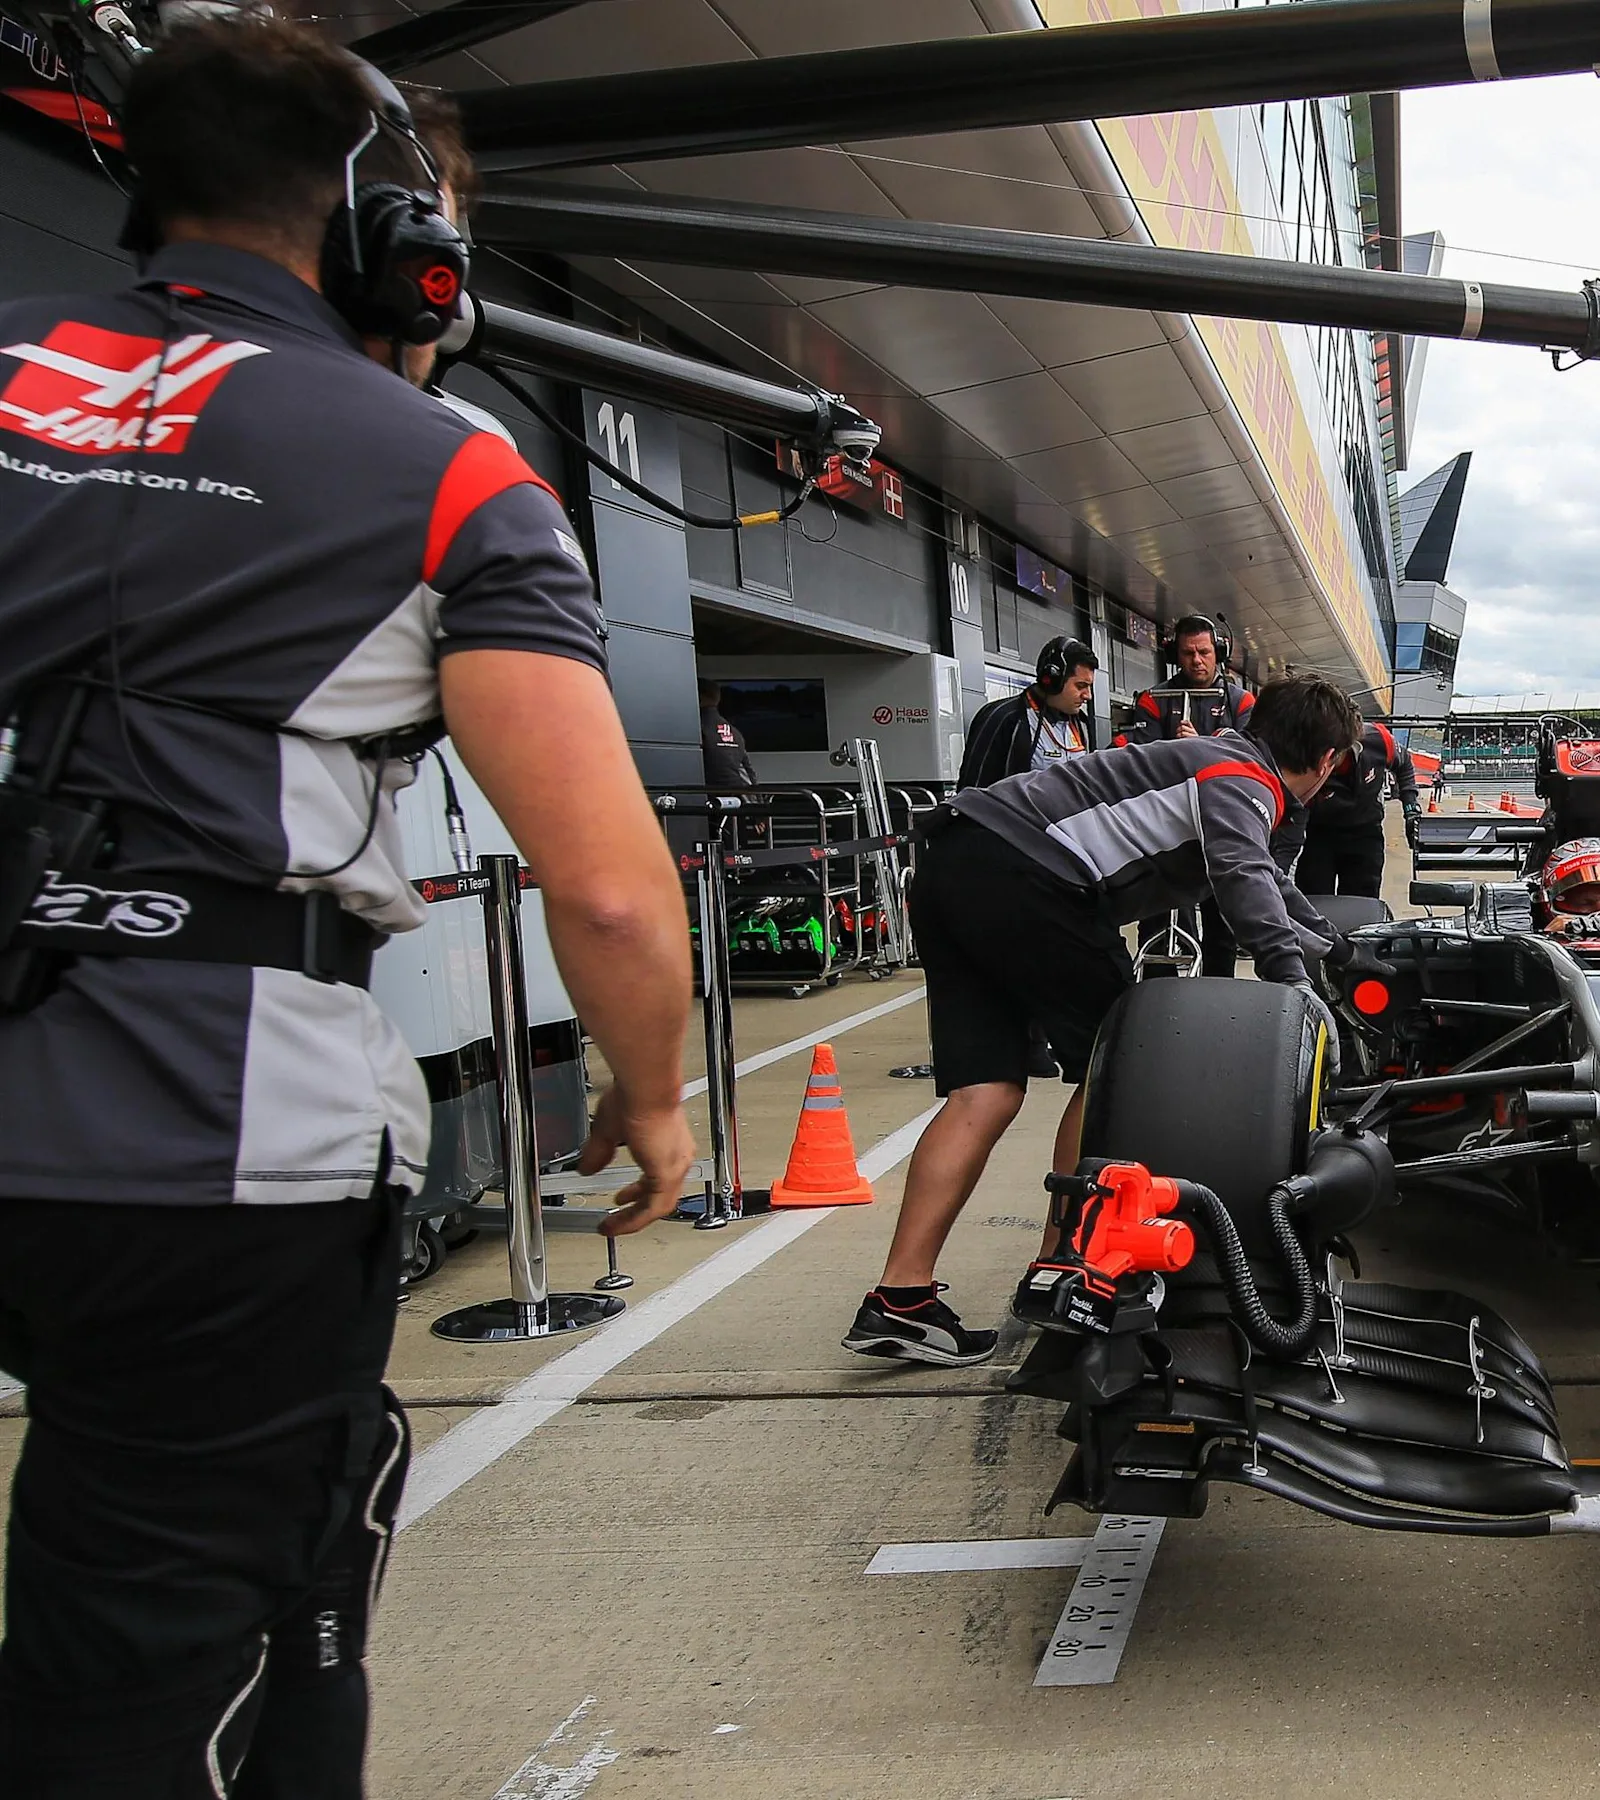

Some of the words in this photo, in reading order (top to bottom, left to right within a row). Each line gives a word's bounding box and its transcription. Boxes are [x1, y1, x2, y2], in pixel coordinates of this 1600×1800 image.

[0, 400, 198, 449] HAAS
[598, 401, 641, 490] 11
[195, 477, 263, 504] Inc.
[951, 561, 969, 614] 10
[895, 706, 929, 717] Haas
[1563, 861, 1580, 872] Haas
[435, 882, 457, 895] Haas
[457, 878, 468, 892] F1
[469, 877, 490, 890] Team
[1104, 1517, 1129, 1530] 10
[1080, 1574, 1108, 1588] 10
[1066, 1605, 1096, 1622] 20
[1053, 1639, 1083, 1658] 30
